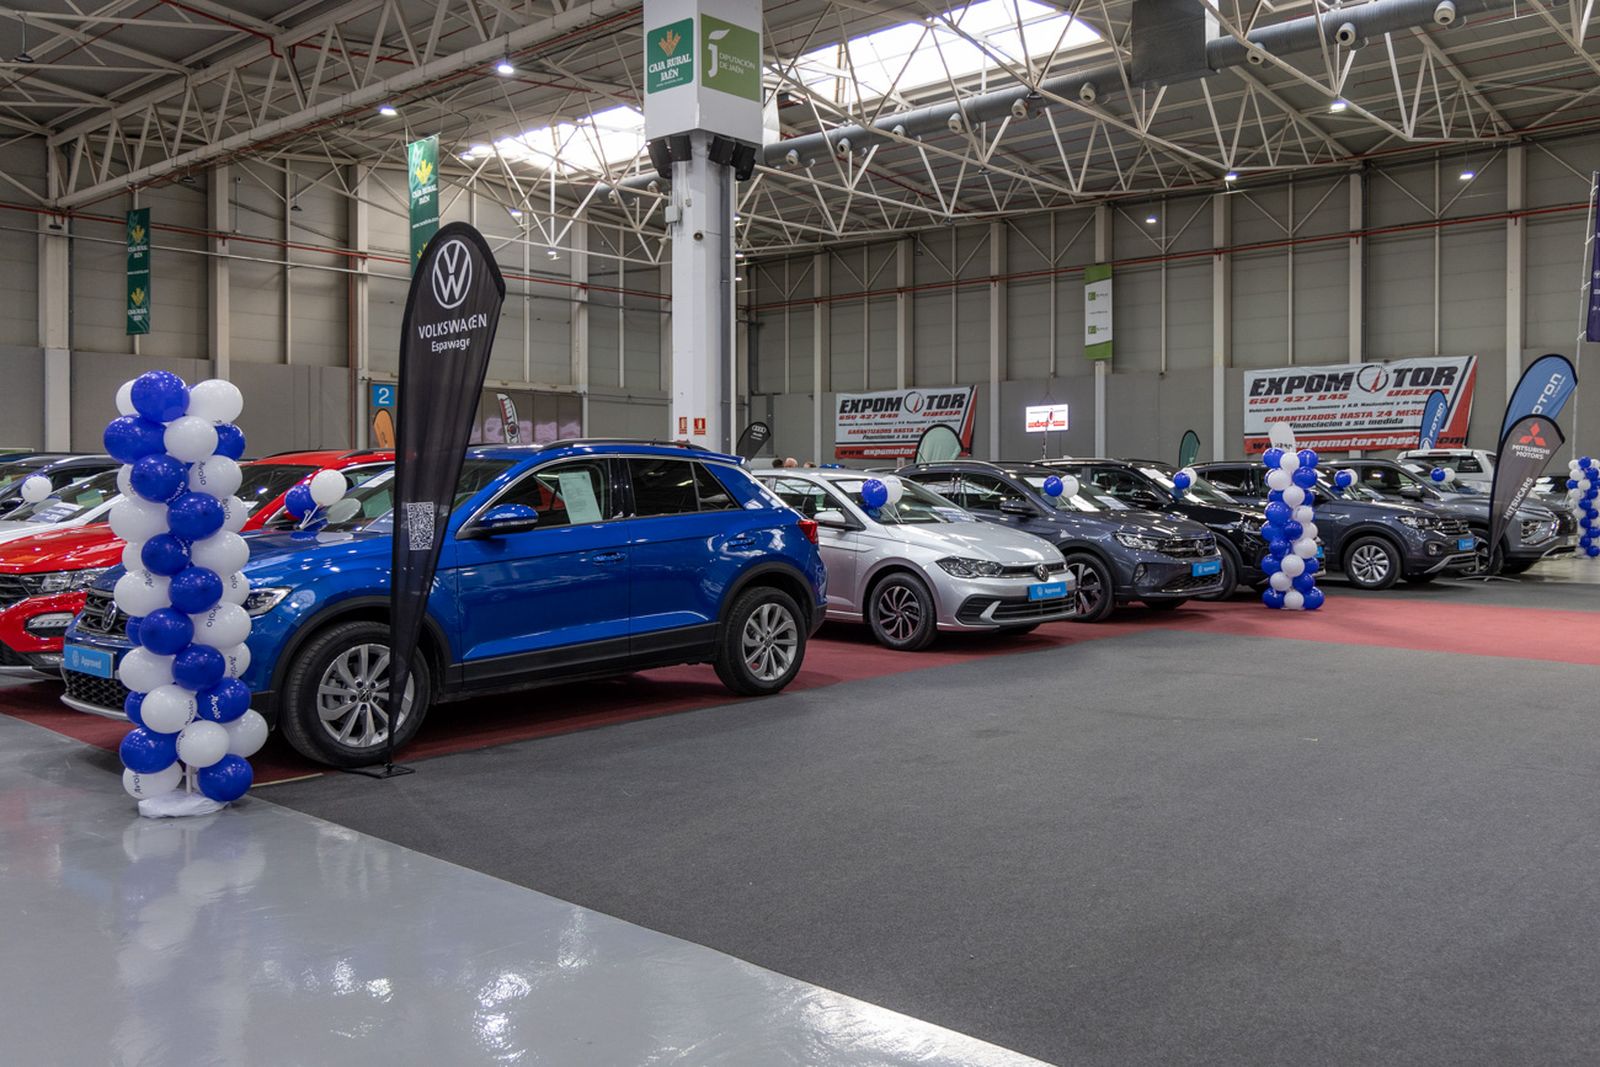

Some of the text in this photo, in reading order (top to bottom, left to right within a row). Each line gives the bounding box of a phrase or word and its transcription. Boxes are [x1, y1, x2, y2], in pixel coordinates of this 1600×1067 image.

[649, 53, 692, 73] CAJA RURAL
[418, 313, 487, 339] VOLKSWAGEN
[378, 387, 390, 404] 2
[1532, 373, 1562, 414] OTON
[1249, 397, 1279, 405] 650
[1264, 409, 1425, 423] GARANTIZADOS HASTA 24 MESE
[1353, 418, 1365, 426] su
[1368, 417, 1404, 425] medida
[1512, 444, 1551, 455] MITSUBISHI
[1516, 451, 1544, 460] MOTORS
